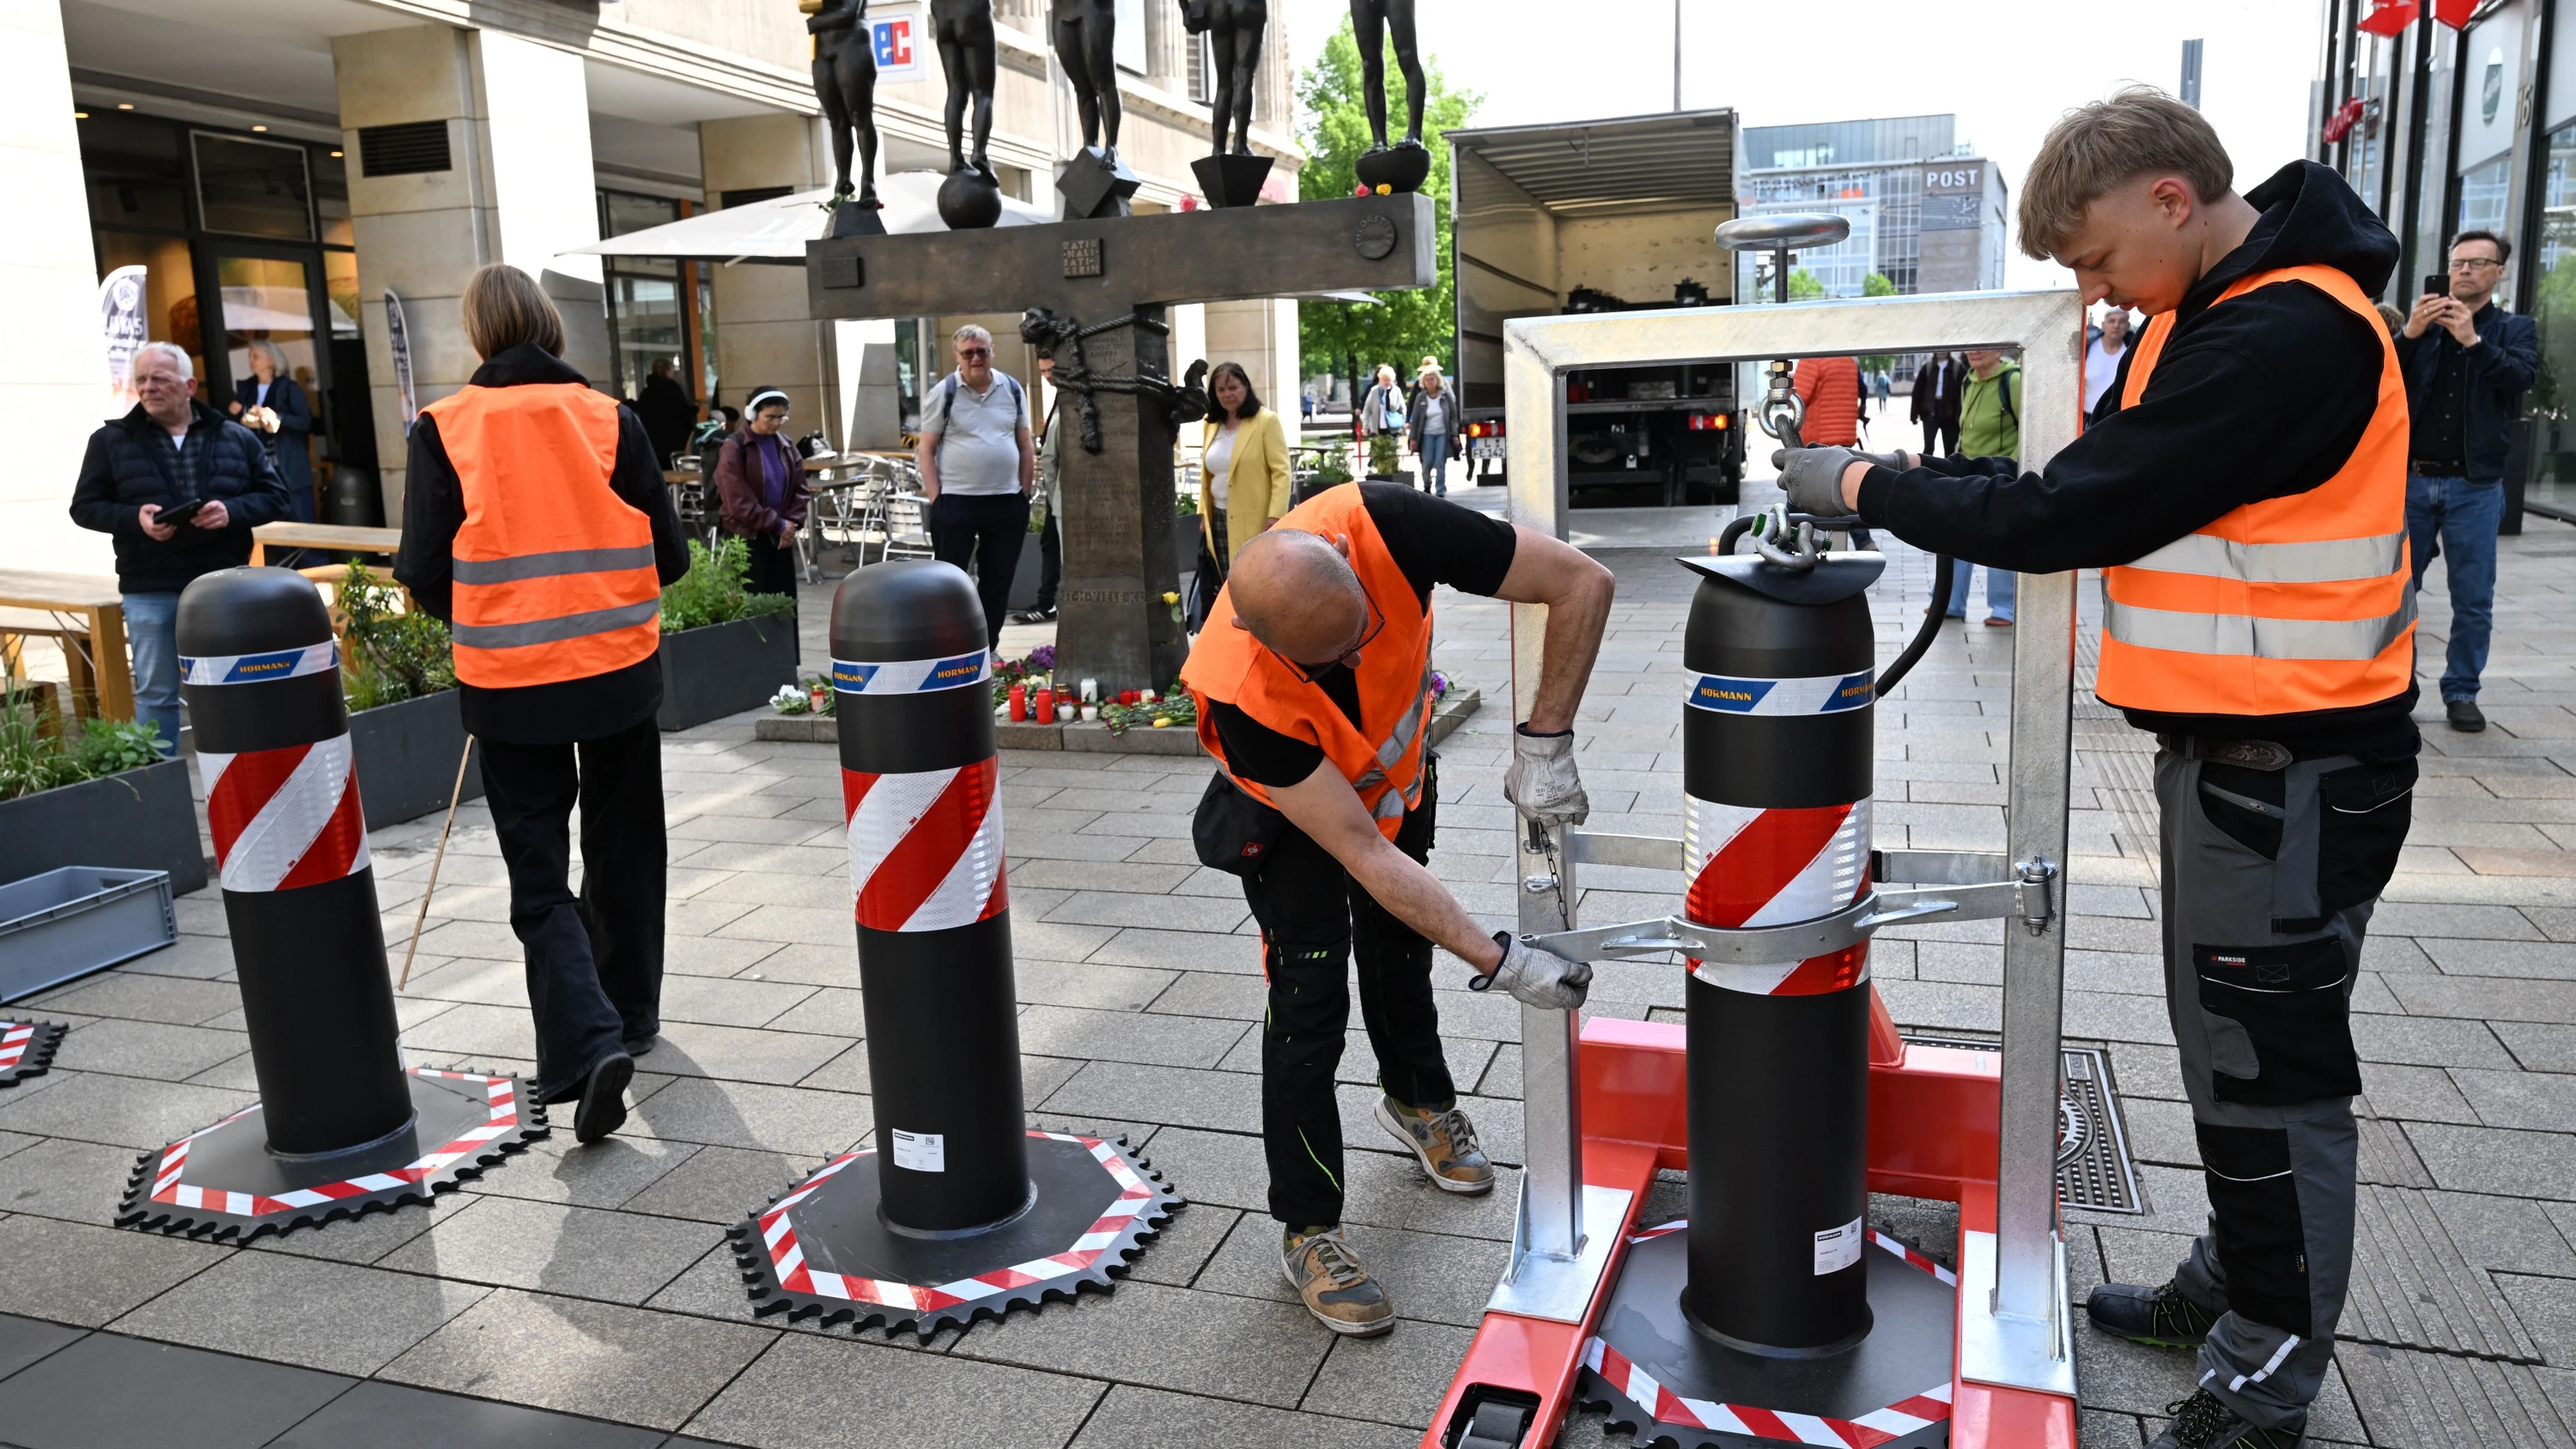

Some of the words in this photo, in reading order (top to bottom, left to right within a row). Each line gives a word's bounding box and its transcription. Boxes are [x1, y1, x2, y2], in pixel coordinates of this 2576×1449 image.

[1927, 169, 1978, 188] POST
[1485, 439, 1491, 448] L
[1705, 852, 1714, 862] 3M
